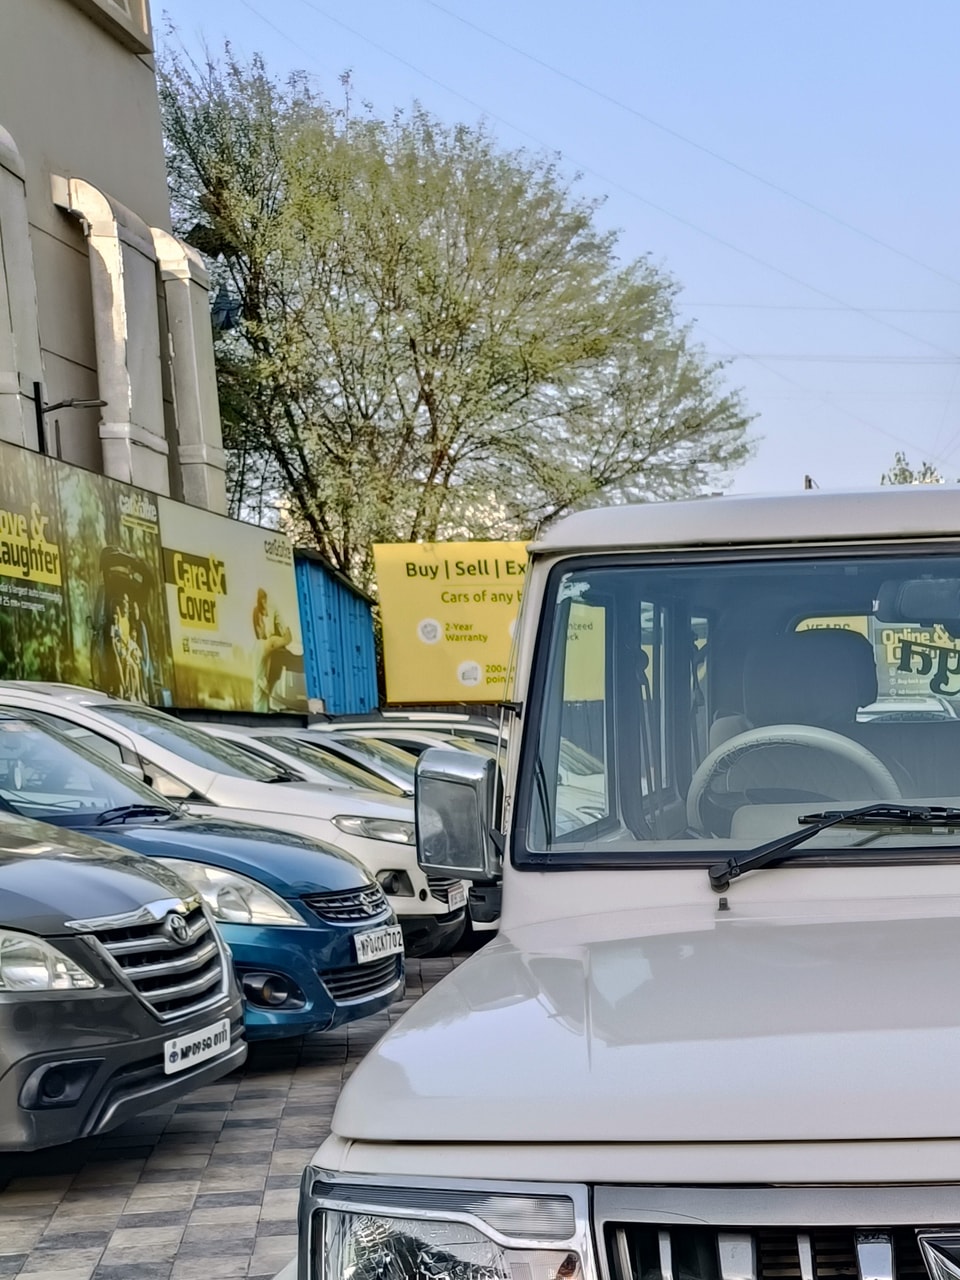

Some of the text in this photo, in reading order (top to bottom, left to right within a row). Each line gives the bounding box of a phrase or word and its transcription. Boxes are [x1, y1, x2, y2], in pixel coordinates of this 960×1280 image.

[0, 509, 28, 538] ove
[0, 541, 59, 577] aughter
[174, 553, 207, 591] Care
[405, 560, 526, 580] Buy Sell Ex
[177, 586, 216, 624] Cover
[441, 591, 470, 603] Cars
[473, 590, 488, 602] of
[490, 592, 513, 605] any
[445, 623, 473, 631] 2-Year
[445, 633, 488, 643] Warranty
[882, 628, 931, 645] Online
[485, 674, 513, 685] poin
